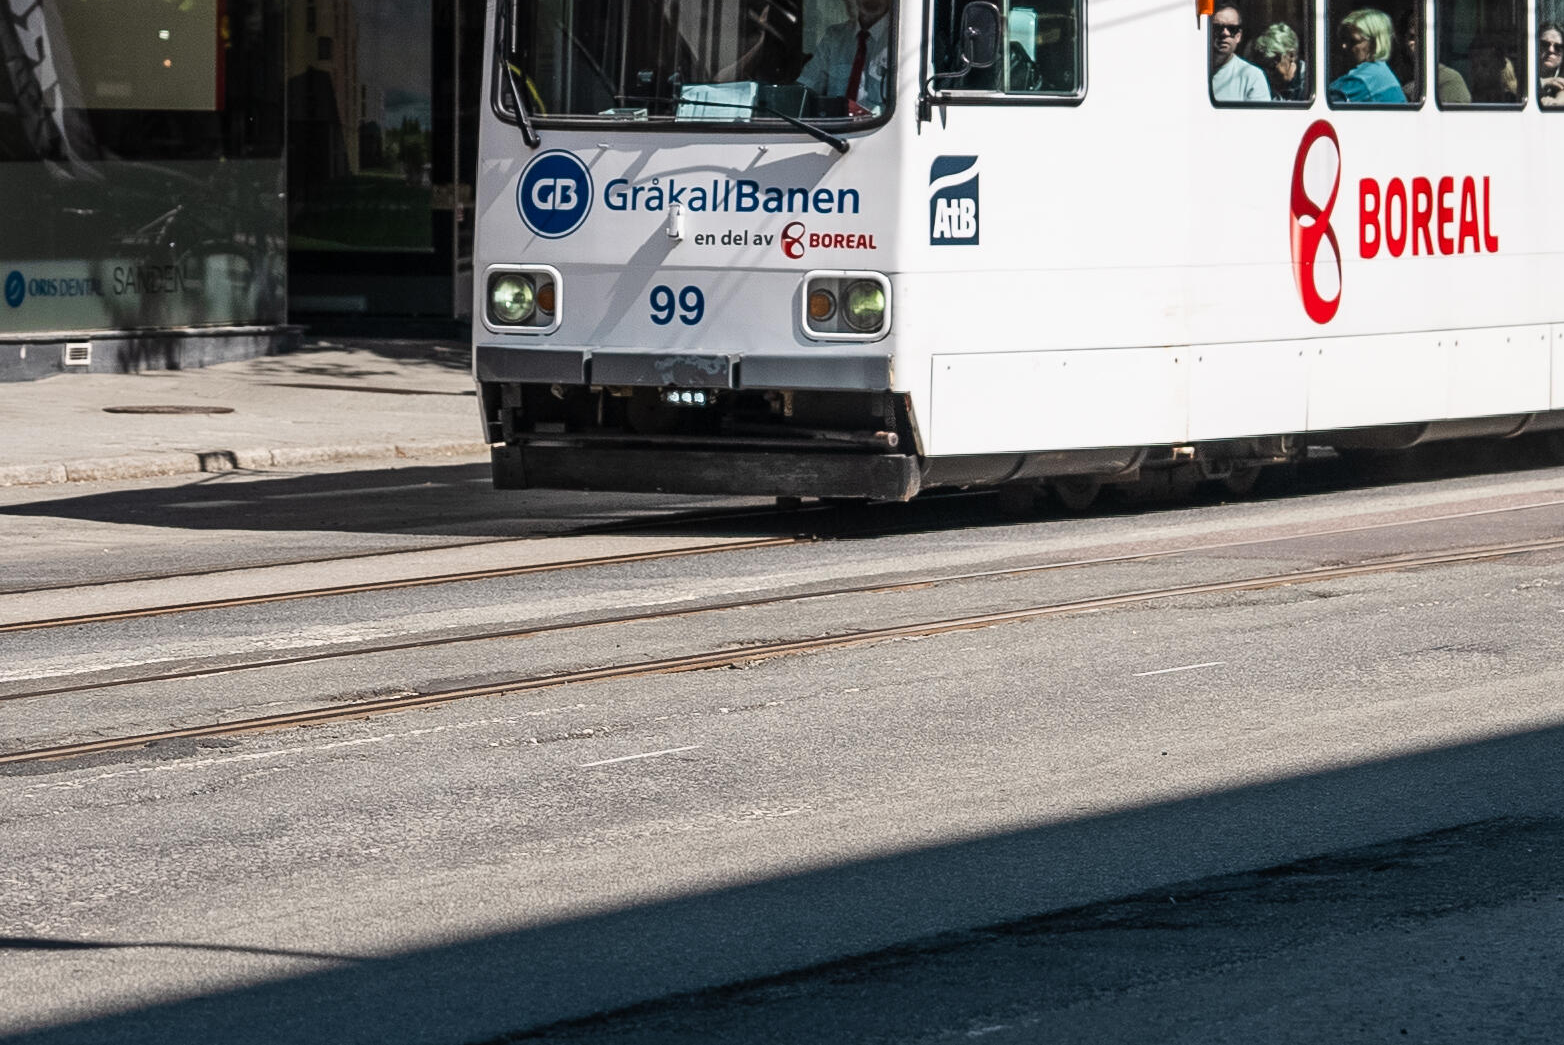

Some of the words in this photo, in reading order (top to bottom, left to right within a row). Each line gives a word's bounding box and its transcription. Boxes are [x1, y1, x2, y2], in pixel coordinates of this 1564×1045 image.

[531, 178, 578, 211] GB
[603, 178, 861, 214] GråkallBanen
[932, 197, 977, 239] AtB
[1359, 175, 1499, 259] BOREAL
[694, 232, 716, 246] en
[720, 229, 749, 247] del
[752, 233, 774, 247] av
[809, 233, 877, 250] BOREAL
[28, 278, 57, 297] ORIS
[59, 278, 105, 297] DENTAL
[650, 285, 705, 326] 99
